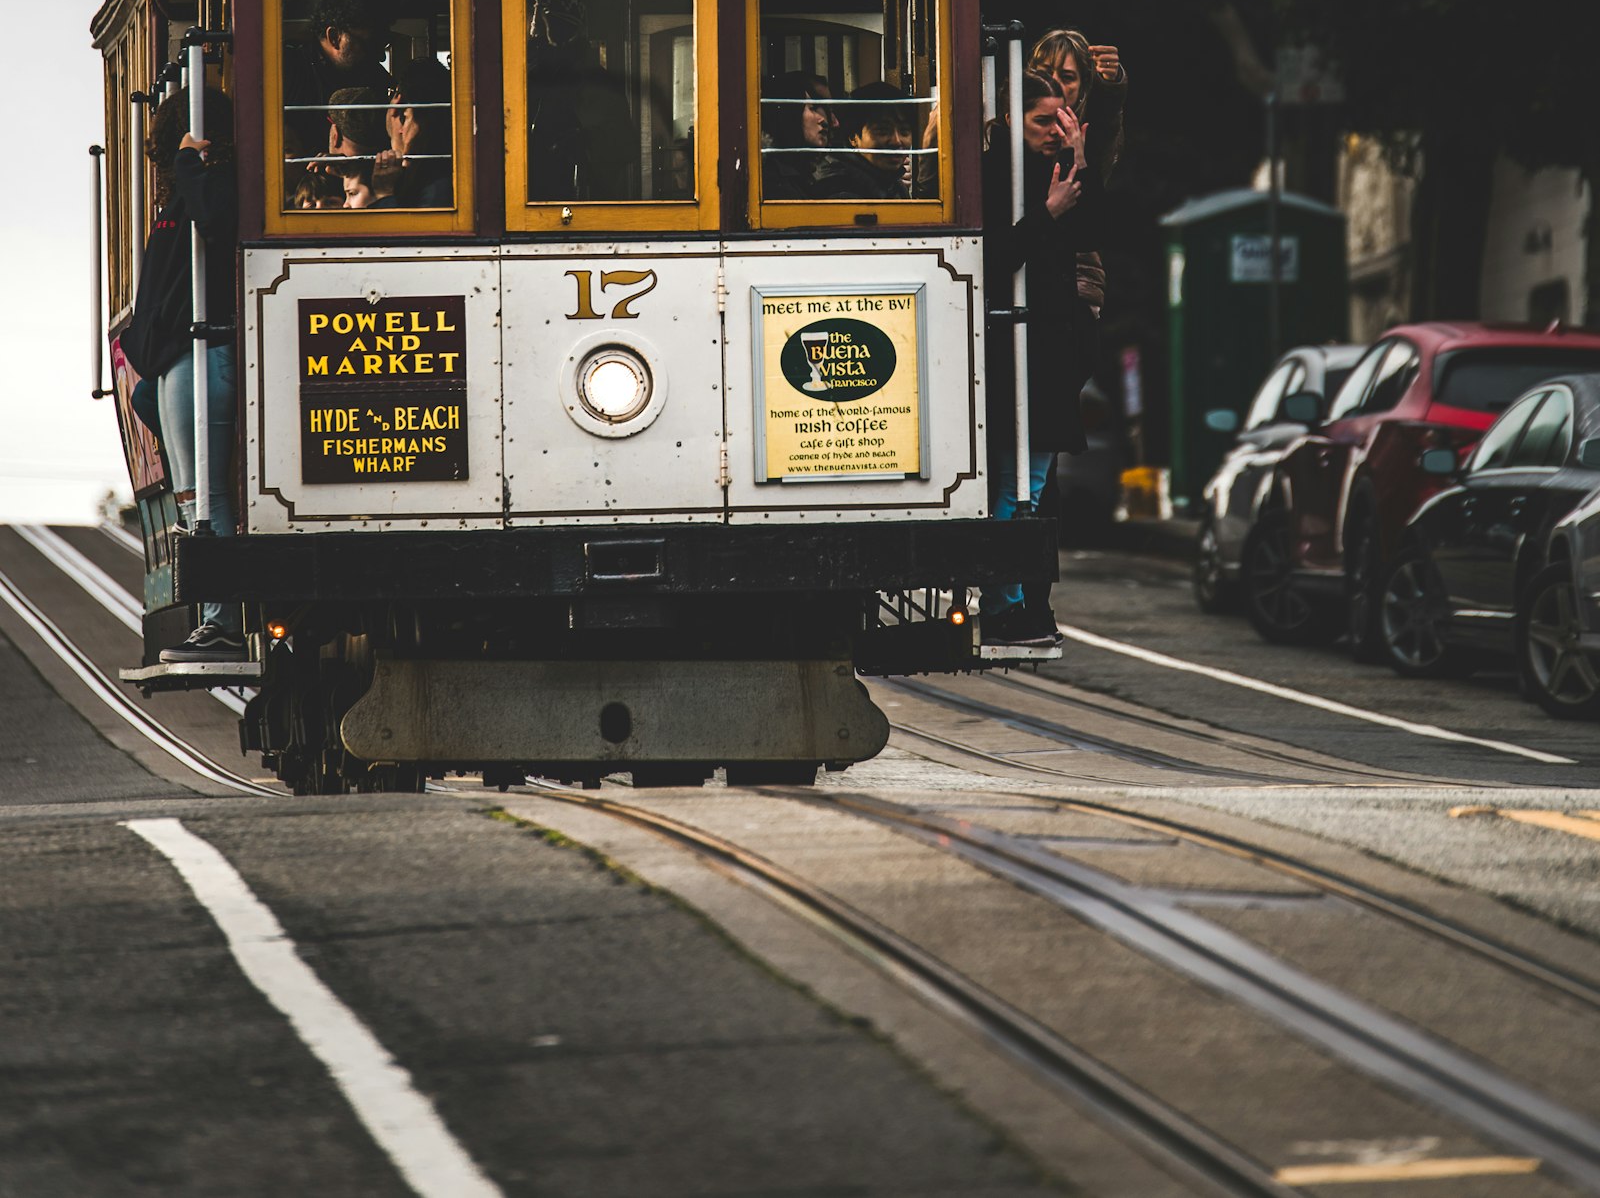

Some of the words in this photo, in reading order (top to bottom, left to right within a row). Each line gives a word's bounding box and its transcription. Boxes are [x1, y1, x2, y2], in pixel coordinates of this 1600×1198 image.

[564, 269, 657, 319] 17
[889, 298, 911, 310] BV!
[309, 311, 455, 335] POWELL
[348, 335, 421, 352] AND
[307, 353, 459, 376] MARKET
[310, 408, 360, 432] HYDE
[366, 409, 390, 431] AND
[394, 406, 459, 431] BEACH
[802, 408, 813, 417] of
[323, 437, 446, 455] FISHERMANS
[353, 456, 416, 473] WHARF
